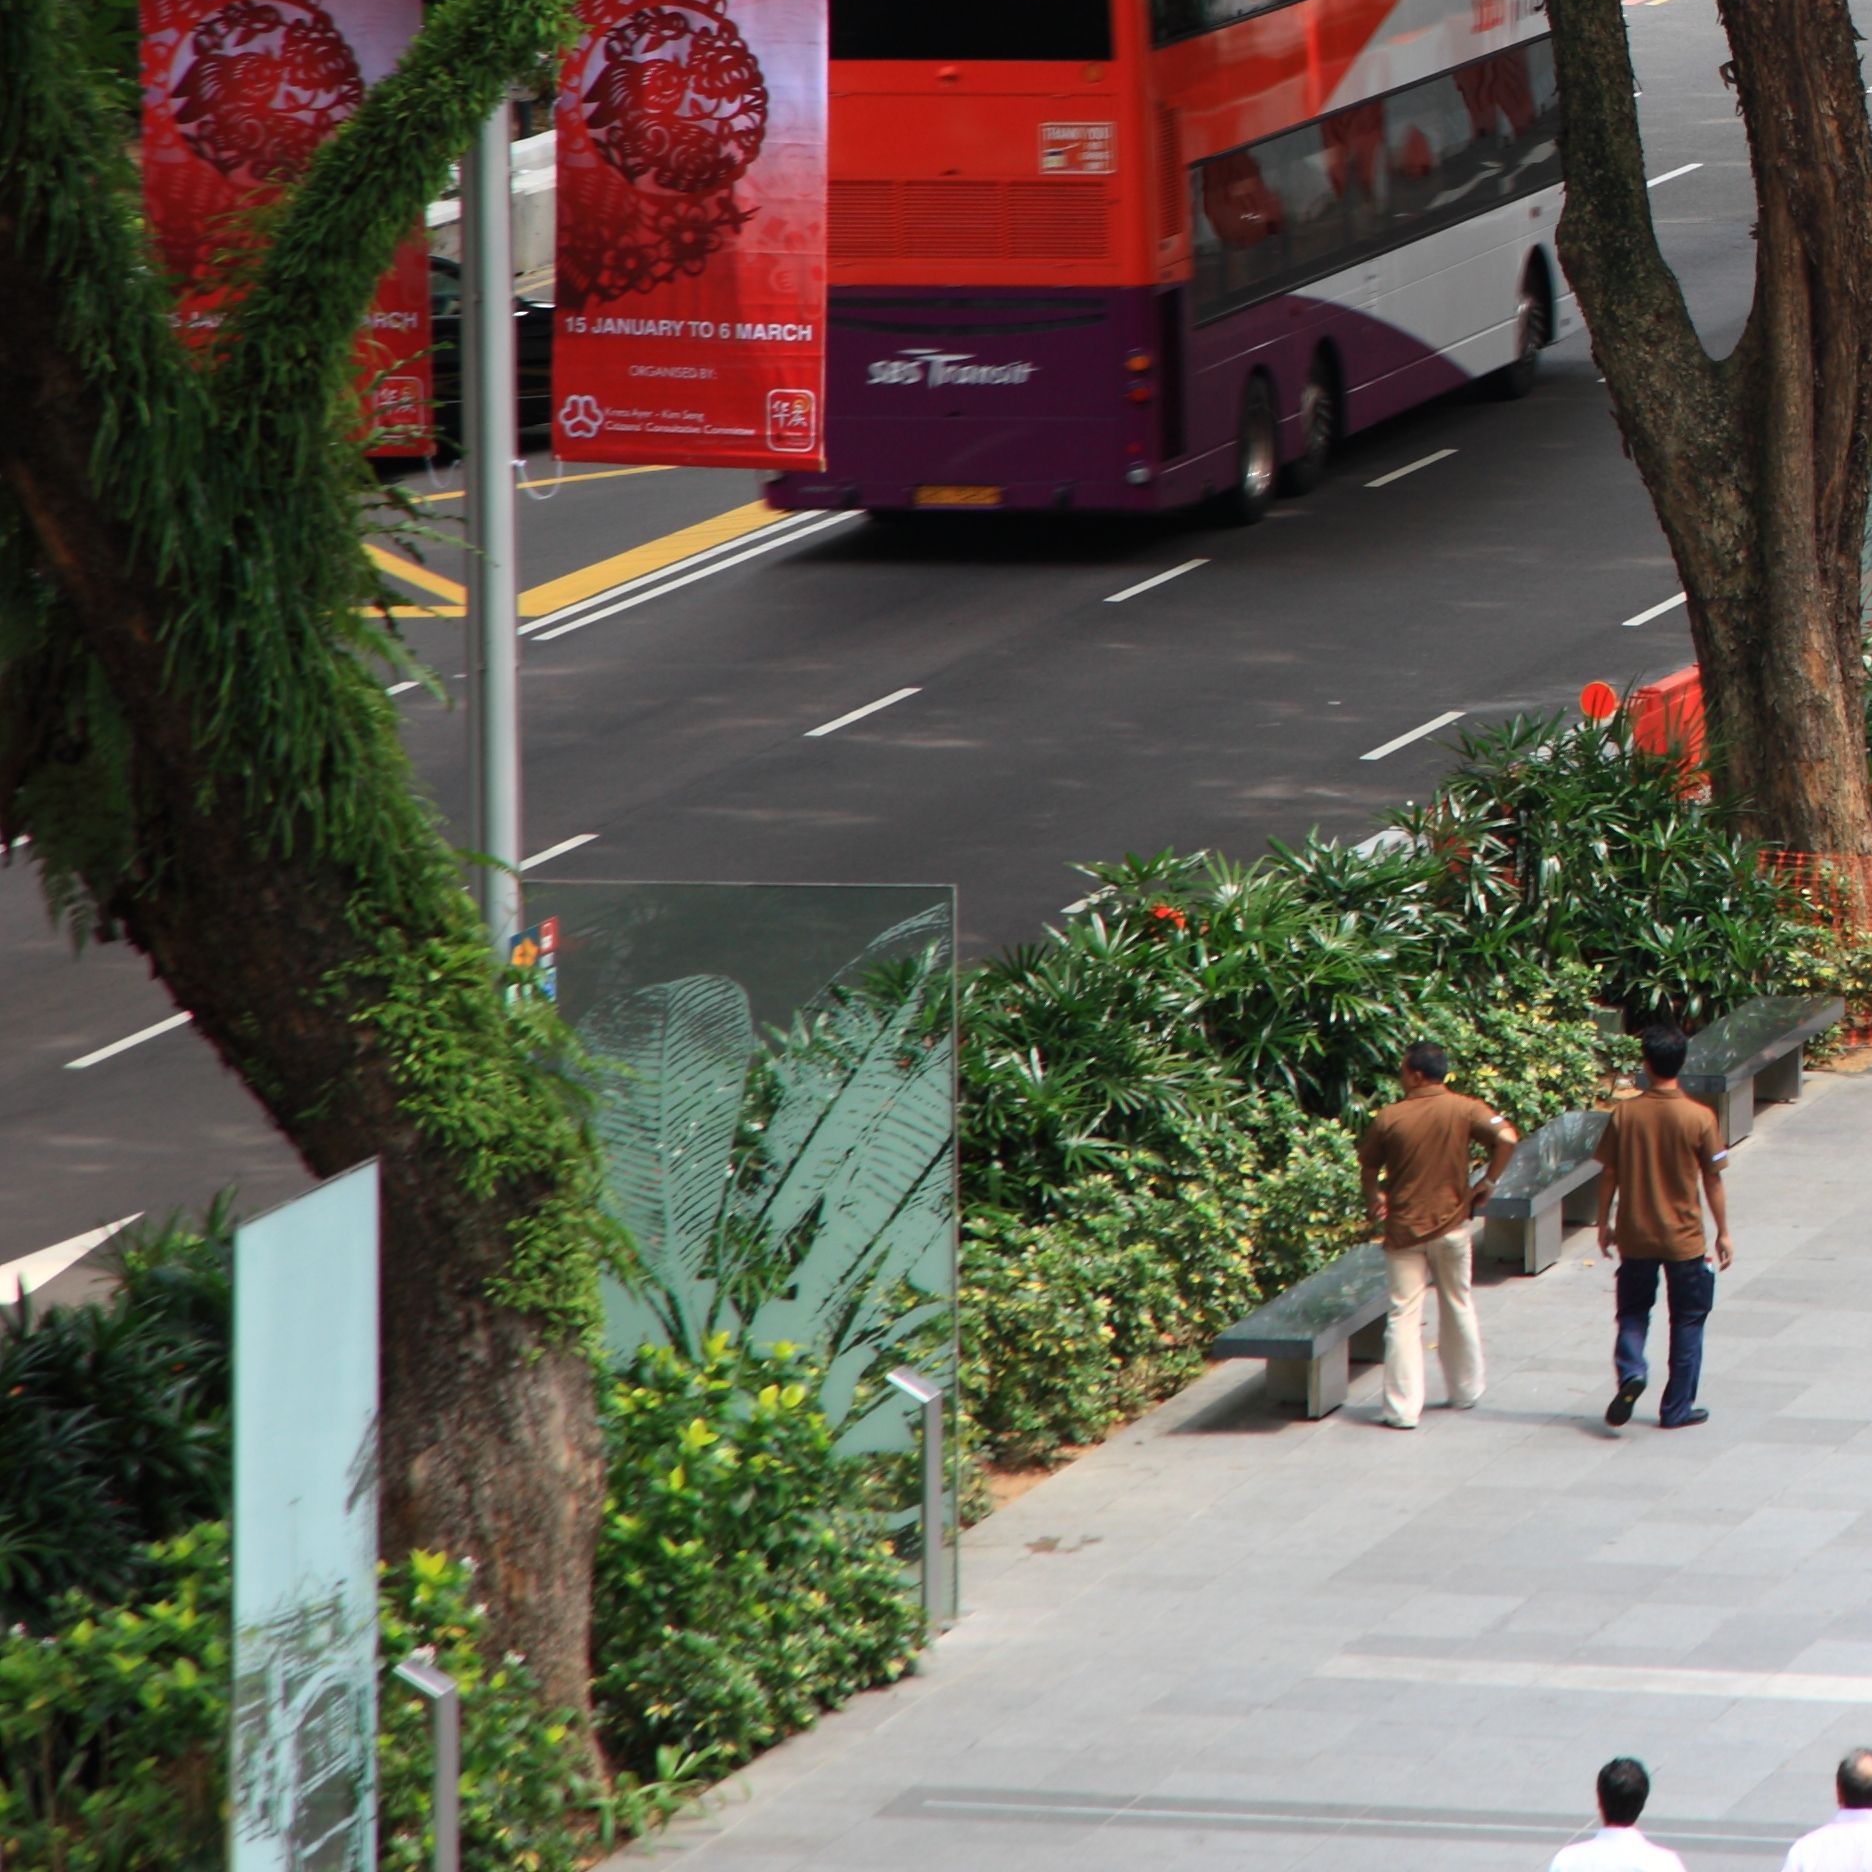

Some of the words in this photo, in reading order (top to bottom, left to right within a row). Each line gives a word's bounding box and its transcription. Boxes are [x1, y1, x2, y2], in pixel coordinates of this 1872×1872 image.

[565, 316, 587, 334] 15
[591, 318, 685, 337] JANUARY
[687, 321, 713, 339] TO
[718, 322, 731, 340] 6
[735, 322, 813, 342] MARCH
[629, 364, 698, 379] ORGANISED
[866, 359, 923, 385] SBS
[914, 354, 1040, 389] Transit
